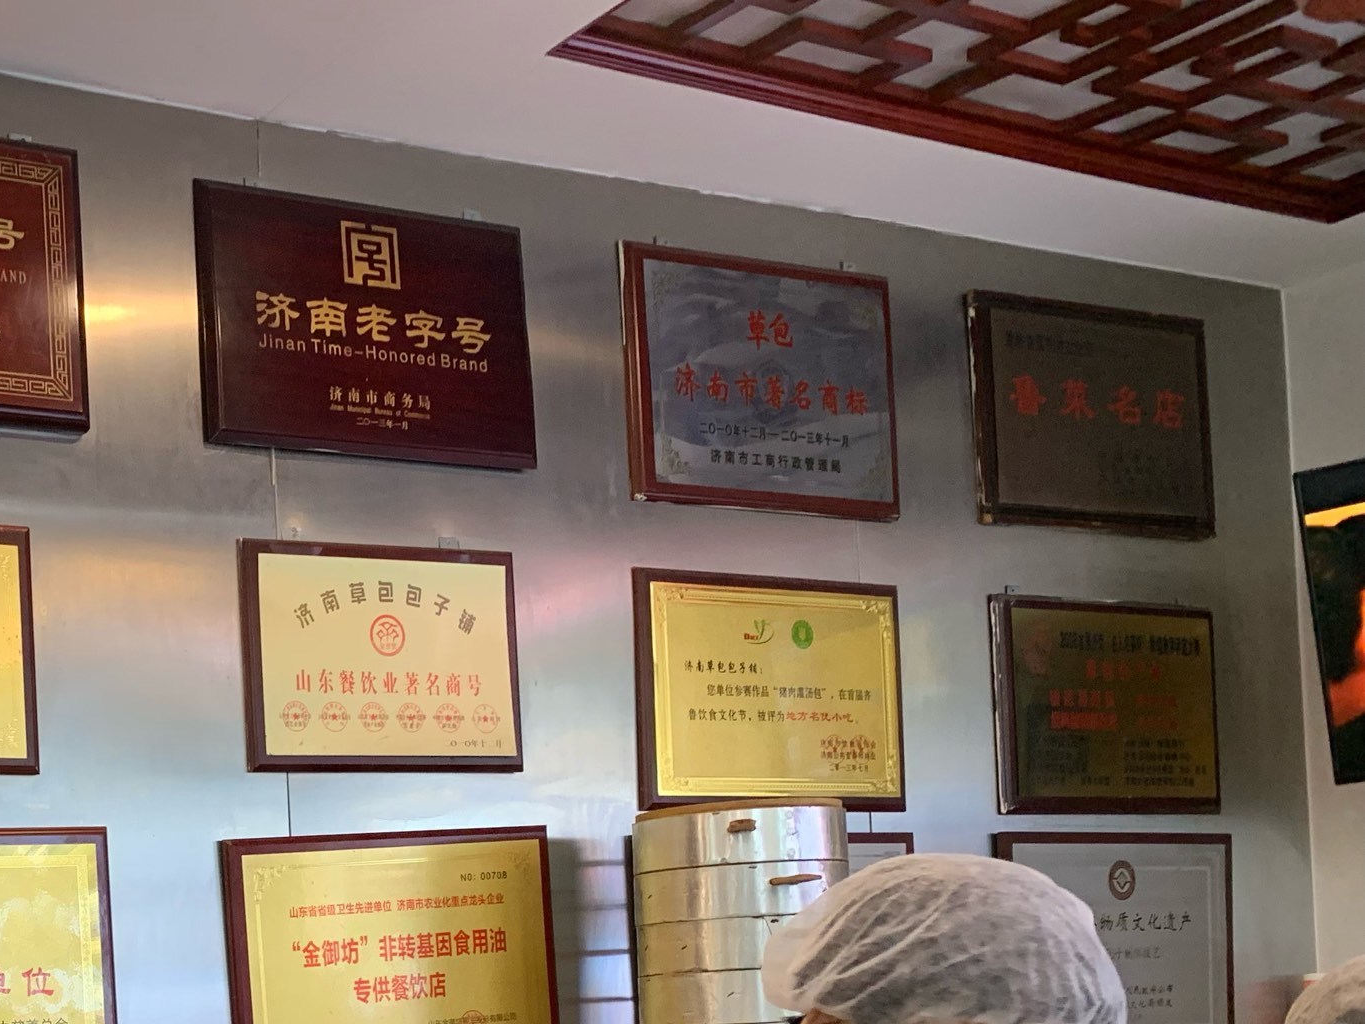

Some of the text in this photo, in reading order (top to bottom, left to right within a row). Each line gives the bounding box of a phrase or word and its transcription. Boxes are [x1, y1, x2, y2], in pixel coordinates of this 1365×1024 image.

[255, 290, 493, 354] 济南老字号
[746, 308, 794, 350] 草包
[258, 333, 489, 373] Jinan Time-Honored Brand
[329, 385, 431, 411] 济南市商务局
[673, 360, 869, 416] 济南市著名商标
[1009, 374, 1185, 428] 鲁菜名店
[293, 580, 477, 635] 济南草包包子铺
[295, 668, 482, 696] 山东餐饮业著名商号
[480, 870, 509, 881] 00708
[289, 900, 393, 919] 山东省省级卫生先进单位
[1095, 910, 1192, 931] 物质文化遗产
[379, 927, 508, 963] 非转基因食用油
[353, 972, 447, 1004] 专供餐饮店
